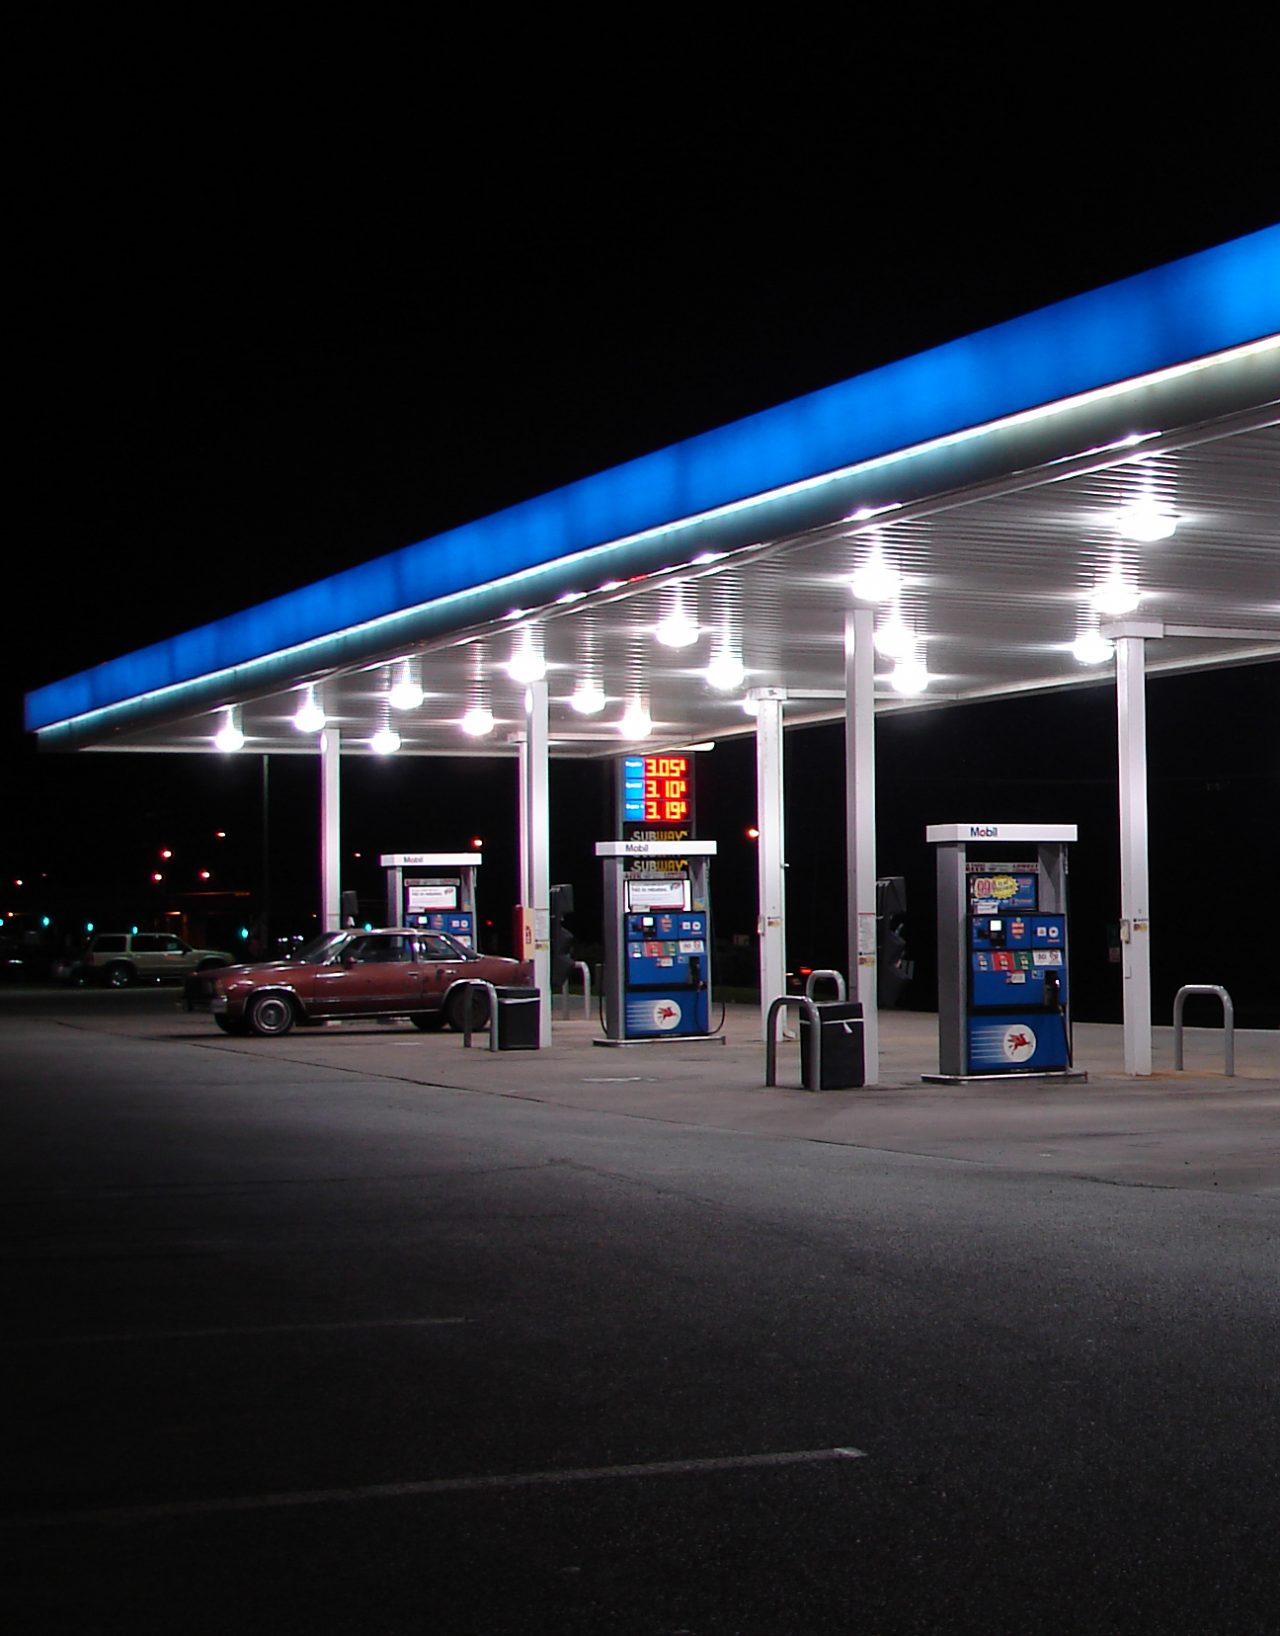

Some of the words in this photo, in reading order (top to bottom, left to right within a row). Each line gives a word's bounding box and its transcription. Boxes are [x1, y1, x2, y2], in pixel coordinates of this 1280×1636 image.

[630, 830, 688, 841] SUBWAY
[970, 827, 998, 837] Mobil
[625, 844, 649, 852] Mobil
[630, 860, 688, 872] SUBWAY
